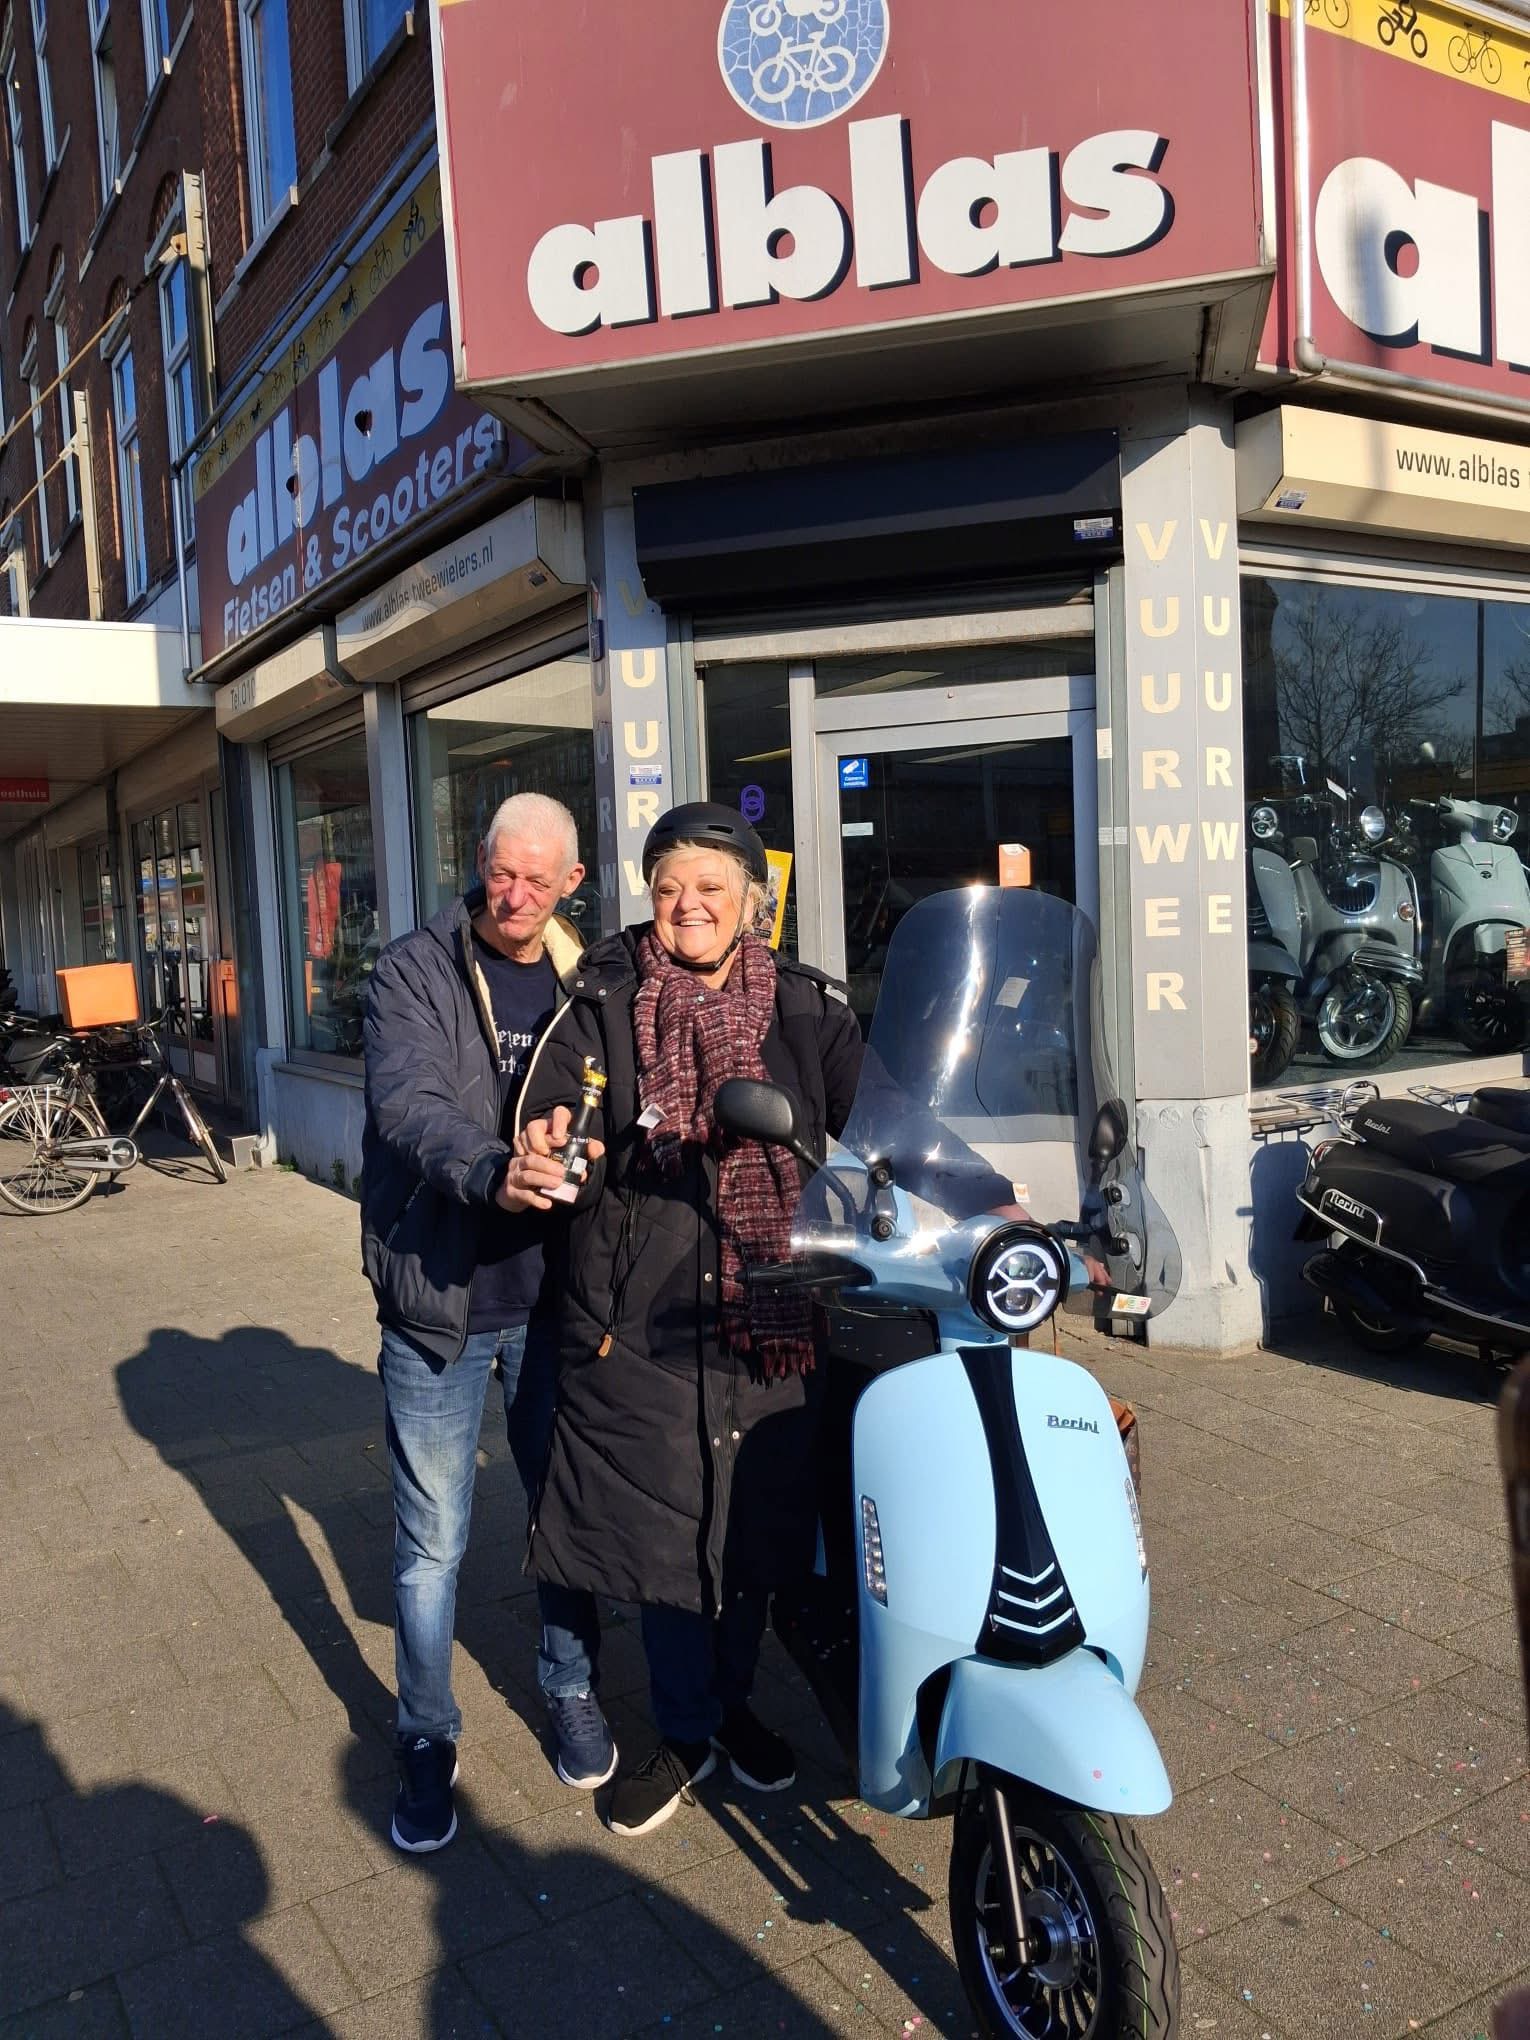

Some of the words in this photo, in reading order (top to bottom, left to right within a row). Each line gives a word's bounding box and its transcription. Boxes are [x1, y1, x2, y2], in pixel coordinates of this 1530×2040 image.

[527, 113, 1174, 335] alblas
[223, 563, 296, 648] Fietsen
[304, 534, 323, 590] &
[332, 411, 495, 570] Scooters
[227, 300, 449, 587] alblas
[1396, 448, 1520, 489] www.alblas
[1135, 518, 1192, 1012] VUURWER
[1364, 1118, 1392, 1135] Berini
[1045, 1414, 1100, 1434] Berini
